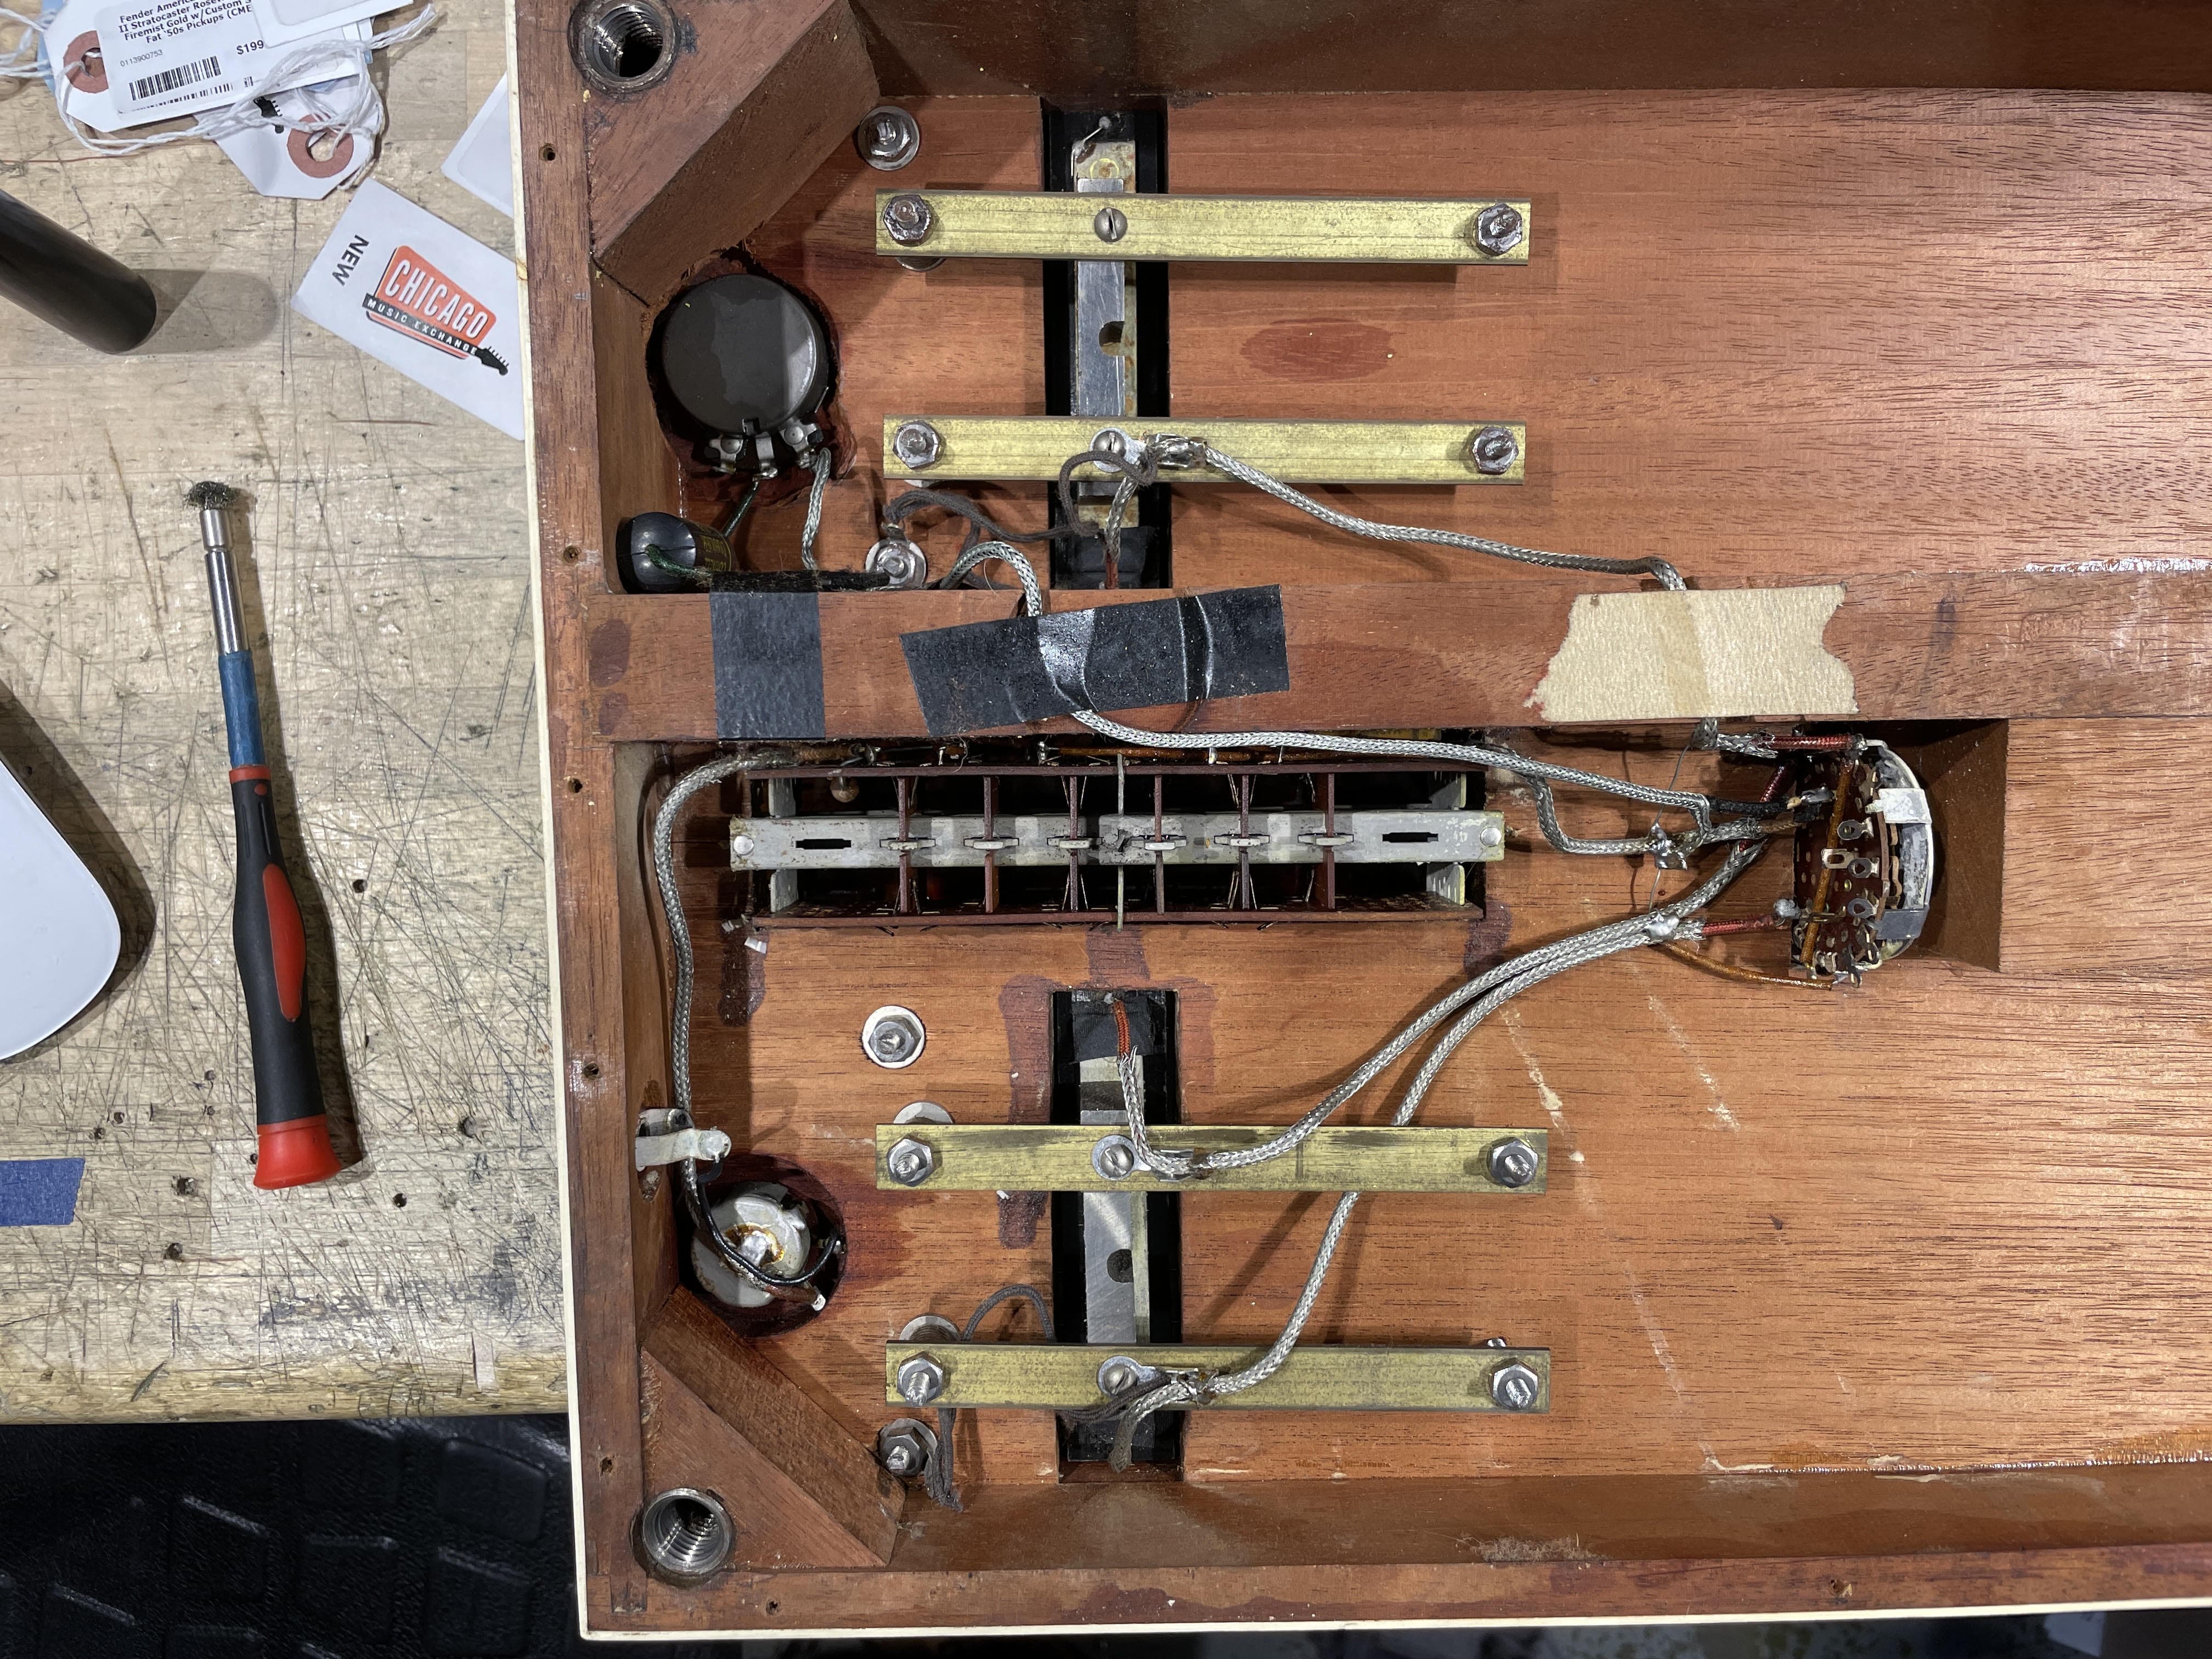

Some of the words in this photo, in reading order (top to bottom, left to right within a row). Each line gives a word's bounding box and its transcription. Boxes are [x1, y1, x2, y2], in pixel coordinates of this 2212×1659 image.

[119, 24, 128, 33] II
[131, 6, 190, 29] Stratocaster
[193, 0, 222, 10] Rose
[120, 9, 153, 23] Fender
[157, 0, 196, 13] Americ
[125, 24, 164, 41] Firemist
[167, 14, 188, 27] Gold
[191, 0, 242, 19] w/Custom
[146, 33, 162, 43] Fat
[187, 14, 224, 30] Pickups
[120, 49, 163, 66] 0113900753
[236, 40, 263, 55] $199
[332, 234, 370, 286] NEW
[385, 259, 489, 339] CHICAGO
[368, 299, 408, 323] MUSIC
[414, 320, 477, 356] EXCHANGE
